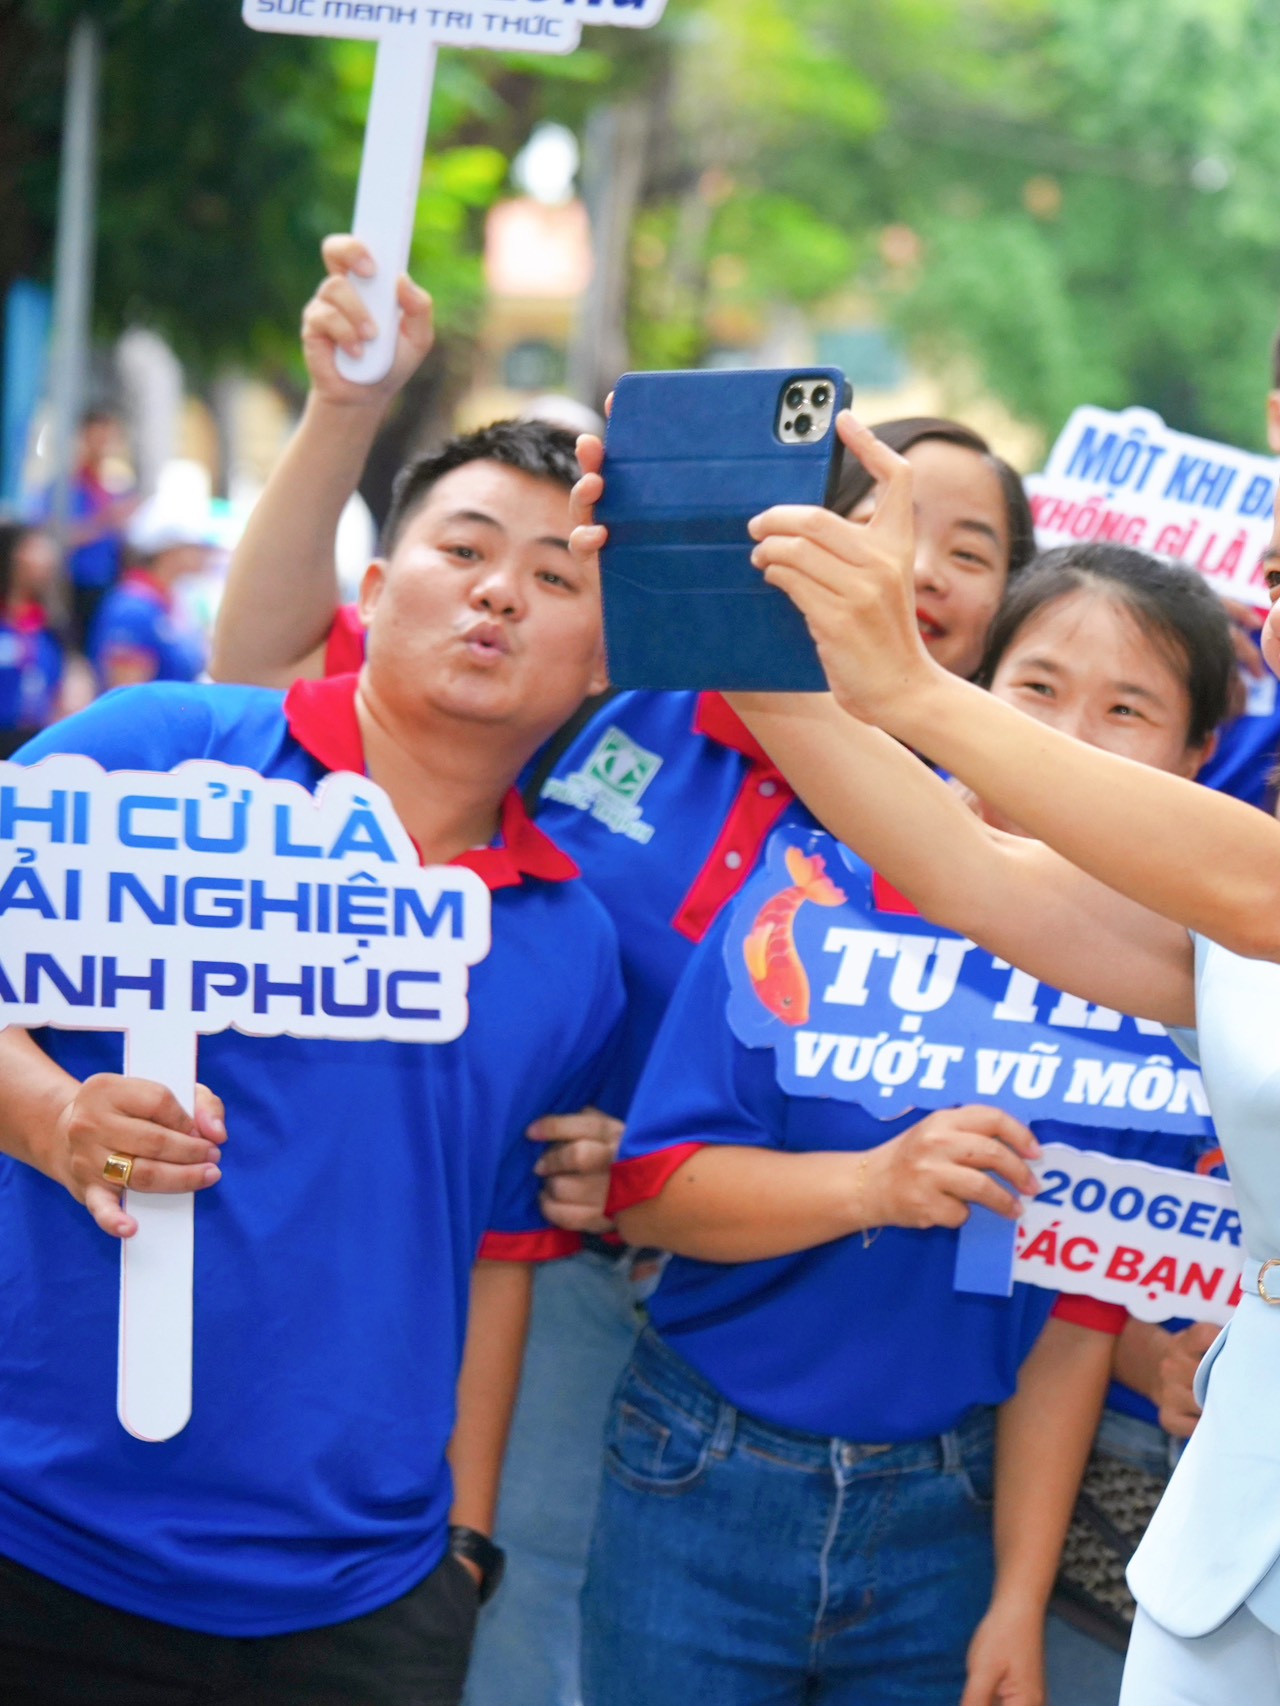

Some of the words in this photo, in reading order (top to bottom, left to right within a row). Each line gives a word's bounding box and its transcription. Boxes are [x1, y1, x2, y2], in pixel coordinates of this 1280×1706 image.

[426, 9, 472, 30] TRI
[481, 13, 564, 38] THỨC
[1065, 426, 1167, 499] MỘT
[1163, 453, 1238, 509] KHI
[1237, 475, 1275, 521] Đ
[1154, 518, 1199, 561] GÌ
[1197, 529, 1248, 580] LÀ
[118, 782, 254, 853] CỬ
[272, 795, 398, 863] LÀ
[108, 871, 465, 948] NGHIỆM
[191, 954, 441, 1020] PHÚC
[822, 926, 980, 1034] TỰ
[794, 1031, 965, 1098] VƯỢT
[975, 1042, 1063, 1099] VŨ
[1016, 1221, 1099, 1273] ÁC
[1104, 1246, 1225, 1301] BẠN
